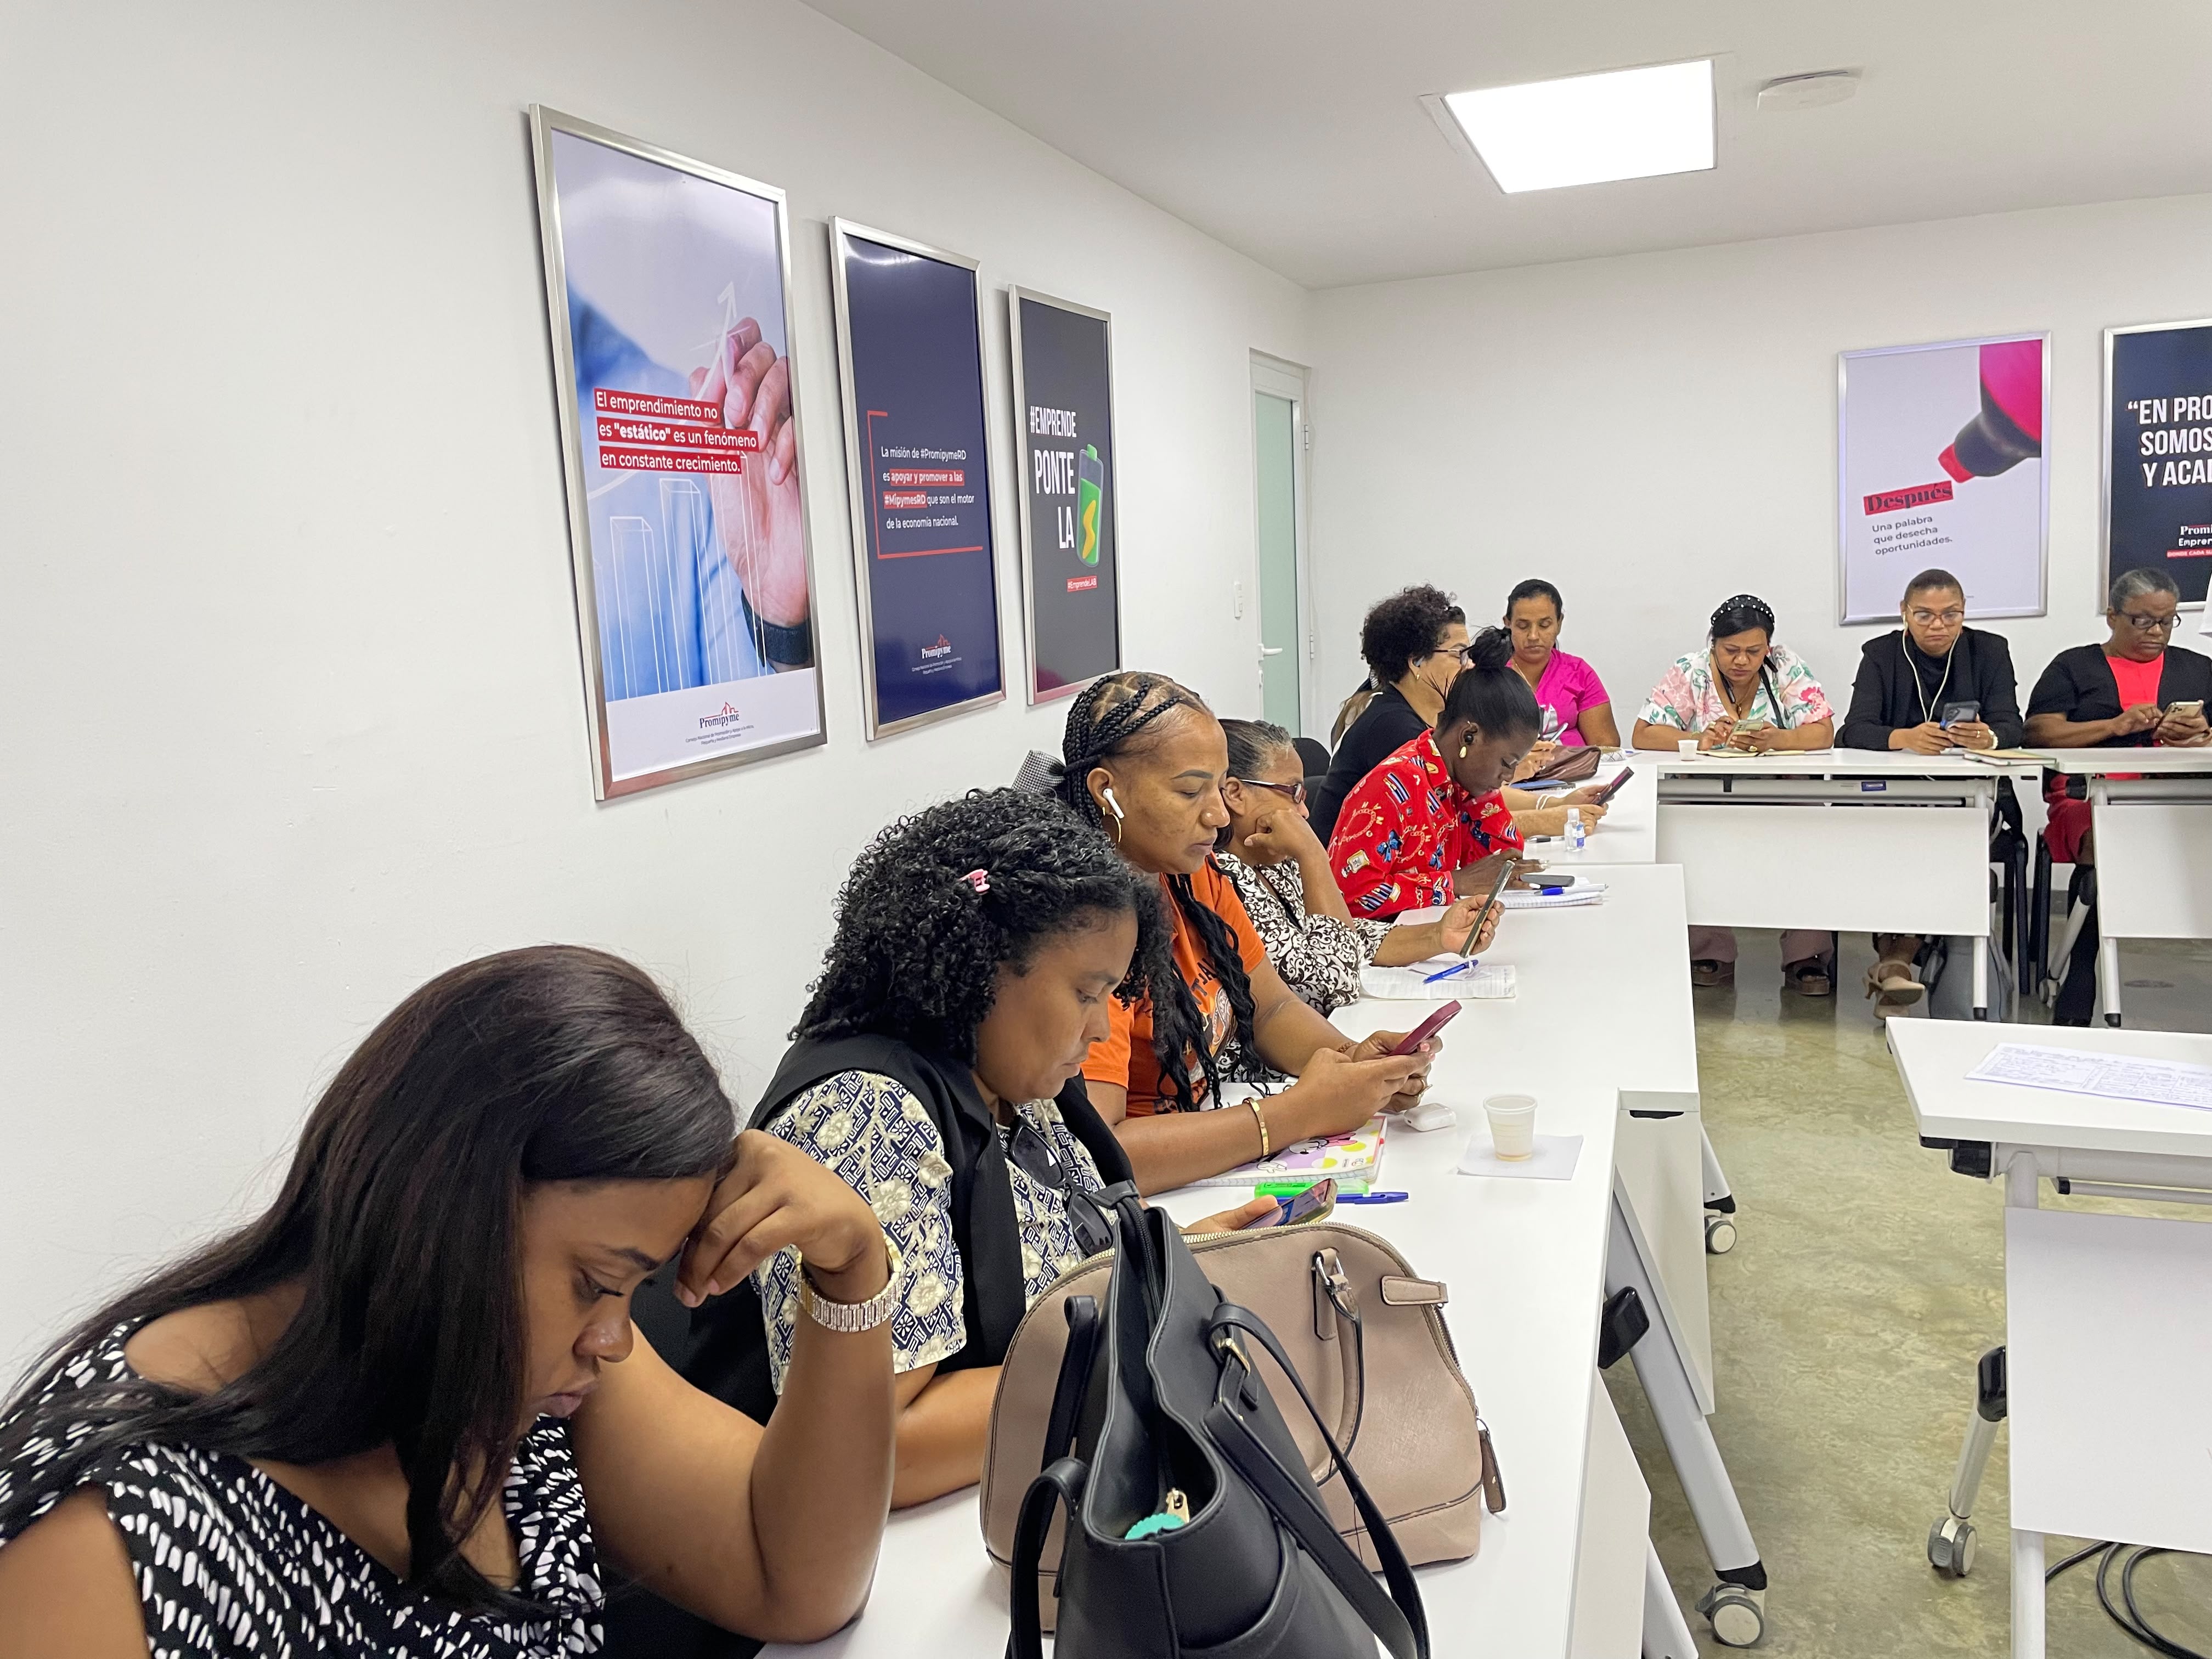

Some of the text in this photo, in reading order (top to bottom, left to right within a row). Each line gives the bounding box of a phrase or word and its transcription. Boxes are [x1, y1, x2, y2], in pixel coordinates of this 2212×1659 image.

[596, 391, 718, 419] El emprendimiento no
[2174, 395, 2212, 422] PRO
[1030, 405, 1077, 438] #EMPRENDE
[599, 422, 757, 448] es "estático" es un fenómeno
[2141, 427, 2212, 456] SOMOS
[602, 454, 741, 472] en constante crecimiento.
[881, 445, 967, 462] La misión de #PromipymeRD
[883, 471, 963, 484] es apoyar y promover a las
[1034, 449, 1075, 494] PONTE
[2142, 462, 2158, 487] Y
[884, 493, 975, 507] #MipymesRD que son el motor
[1867, 483, 1953, 511] Después
[886, 515, 959, 529] de la economía nacional.
[1058, 506, 1075, 549] LA
[1872, 516, 1933, 532] Una palabra
[1874, 527, 1938, 544] que desecha
[1875, 536, 1953, 555] oportunidades.
[921, 645, 951, 659] Promipyme
[699, 713, 740, 729] Promipyme
